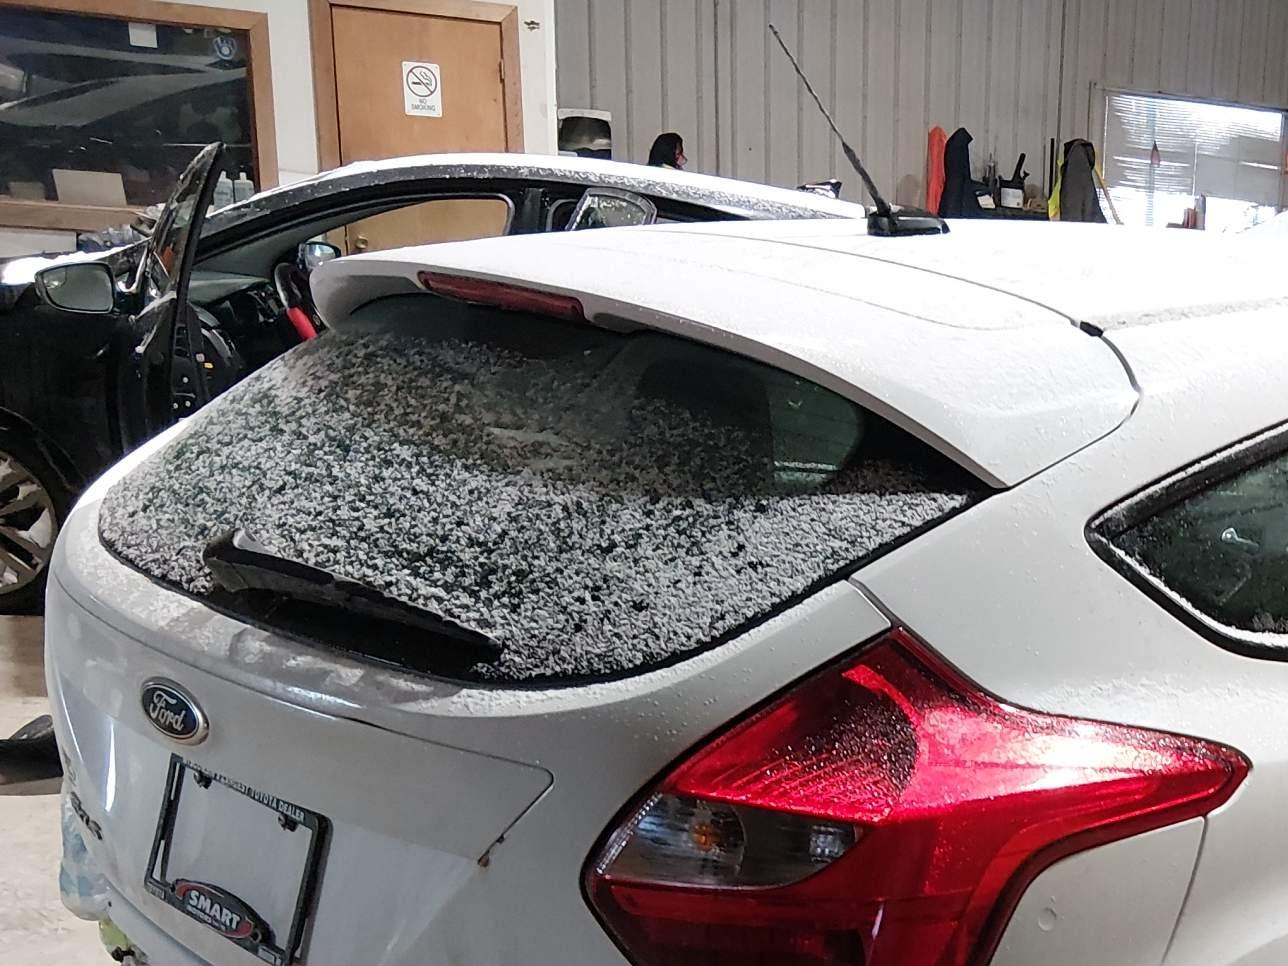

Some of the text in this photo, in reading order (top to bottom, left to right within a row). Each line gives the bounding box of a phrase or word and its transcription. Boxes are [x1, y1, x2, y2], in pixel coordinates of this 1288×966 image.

[411, 103, 436, 111] SMOKING
[150, 690, 186, 731] Ford
[247, 786, 305, 822] TOYOTA DEALER
[188, 889, 241, 930] SMART
